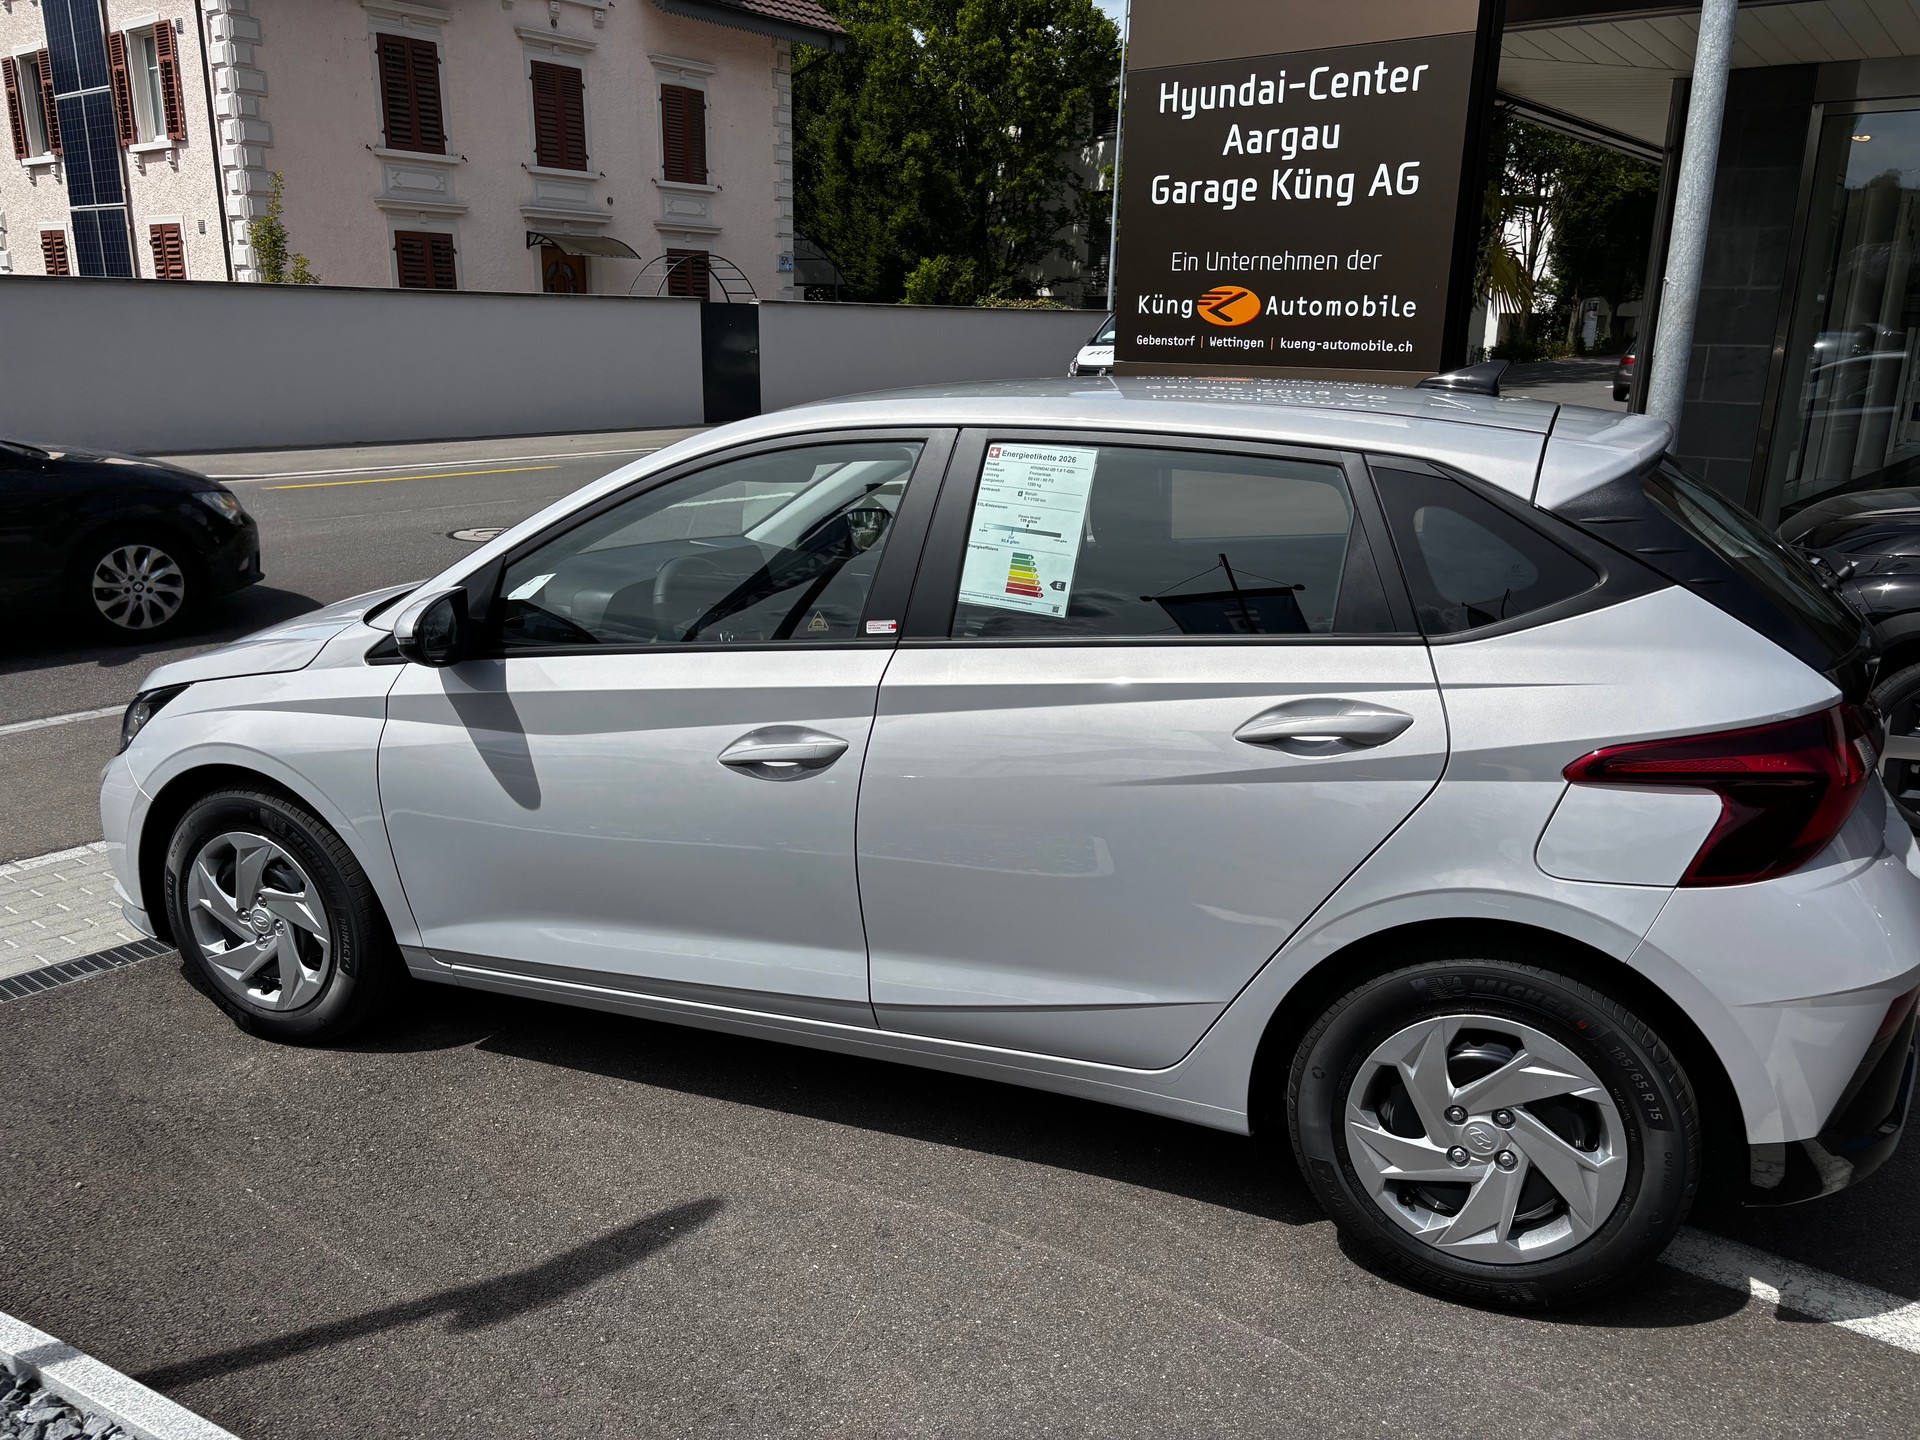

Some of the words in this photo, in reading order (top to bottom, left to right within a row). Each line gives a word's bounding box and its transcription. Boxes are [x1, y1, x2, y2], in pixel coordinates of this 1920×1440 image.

[1159, 61, 1429, 120] Hyundai-Center
[1222, 124, 1340, 160] Aargau
[1151, 174, 1258, 210] Garage
[1271, 168, 1355, 206] Küng
[1368, 161, 1420, 196] AG
[1171, 251, 1199, 271] Ein
[1206, 250, 1338, 271] Unternehmen
[1346, 250, 1382, 270] der
[1138, 294, 1193, 319] Küng
[1266, 295, 1417, 317] Automobile
[1136, 335, 1195, 346] Gebenstorf
[1209, 337, 1264, 348] Wettingen
[1280, 338, 1413, 352] kueng-automobile.ch
[1002, 449, 1057, 462] Energieetikette
[1058, 455, 1077, 464] 2026
[339, 919, 351, 963] PRIMACY
[1608, 1046, 1649, 1089] 185/65
[1641, 1092, 1656, 1103] R
[1647, 1105, 1664, 1121] 15
